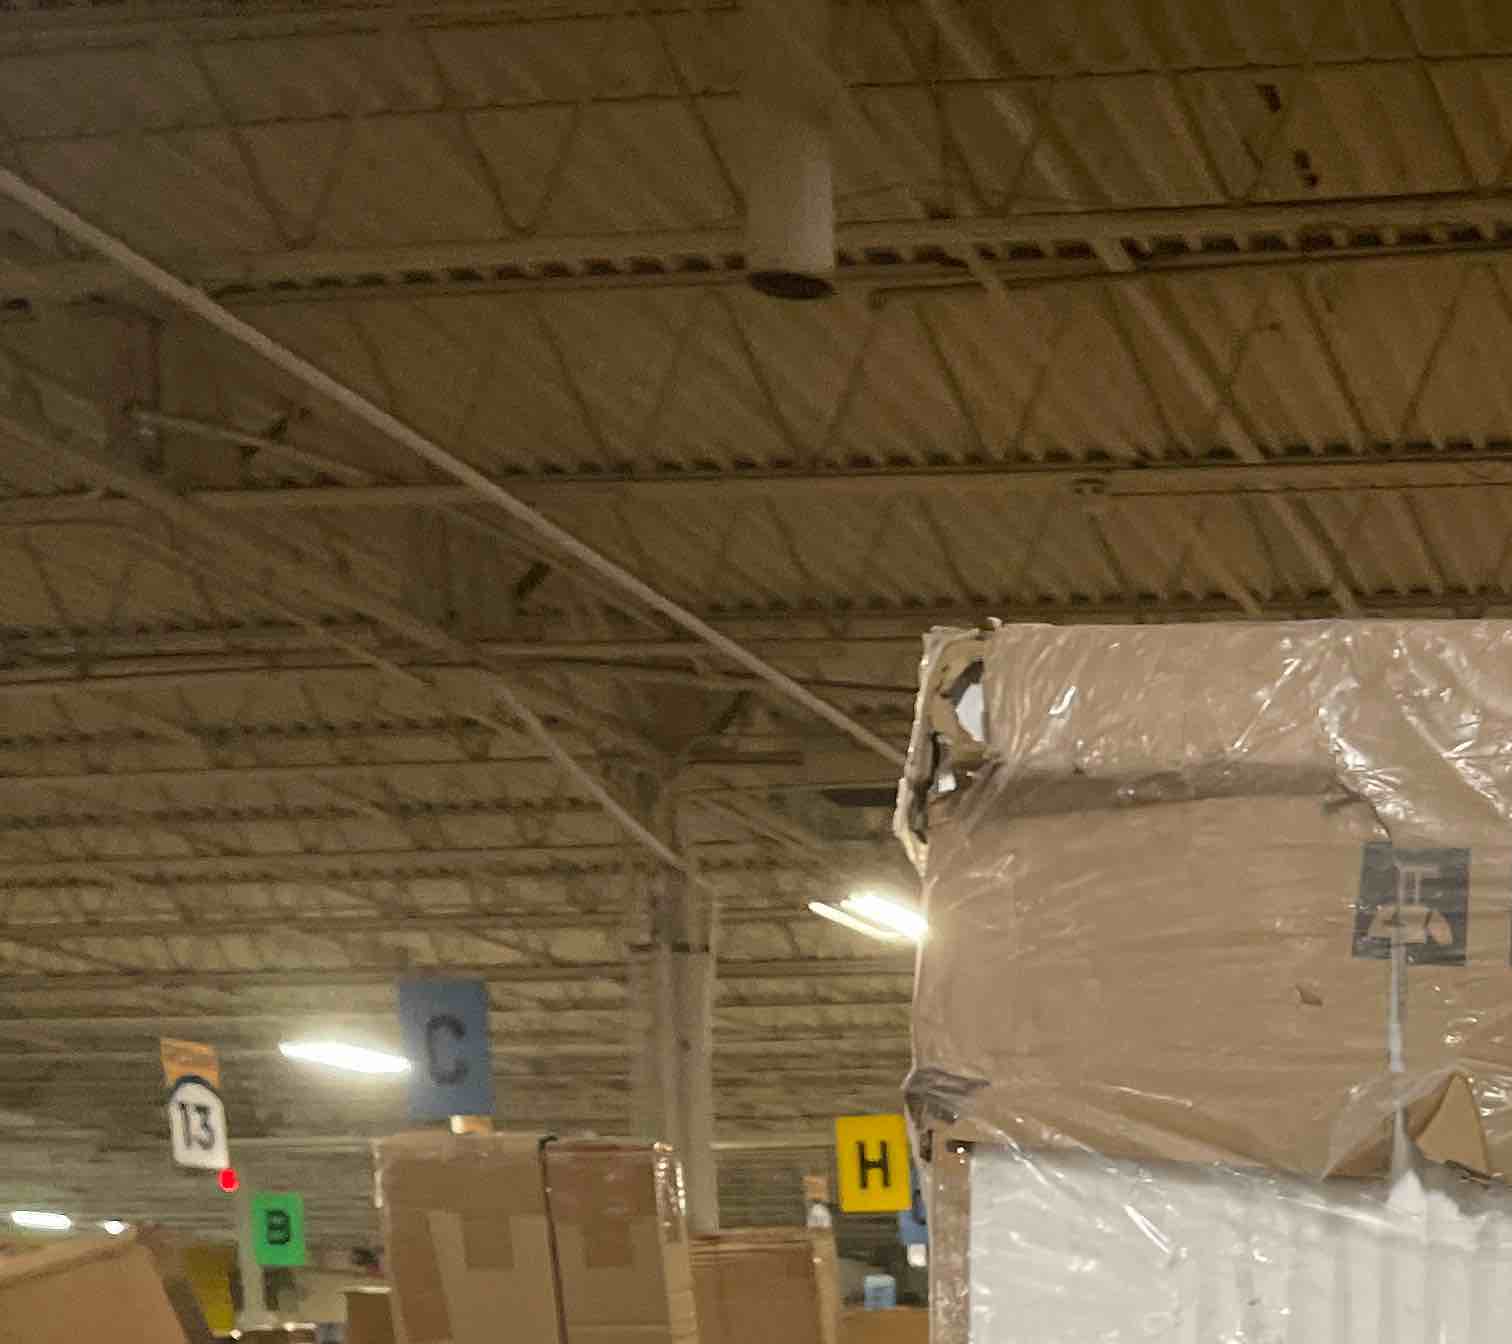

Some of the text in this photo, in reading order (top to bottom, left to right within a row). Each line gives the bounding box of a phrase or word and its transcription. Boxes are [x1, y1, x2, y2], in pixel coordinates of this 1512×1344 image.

[426, 1014, 468, 1086] C
[178, 1100, 216, 1150] 13
[856, 1139, 891, 1189] H
[265, 1209, 291, 1246] B
